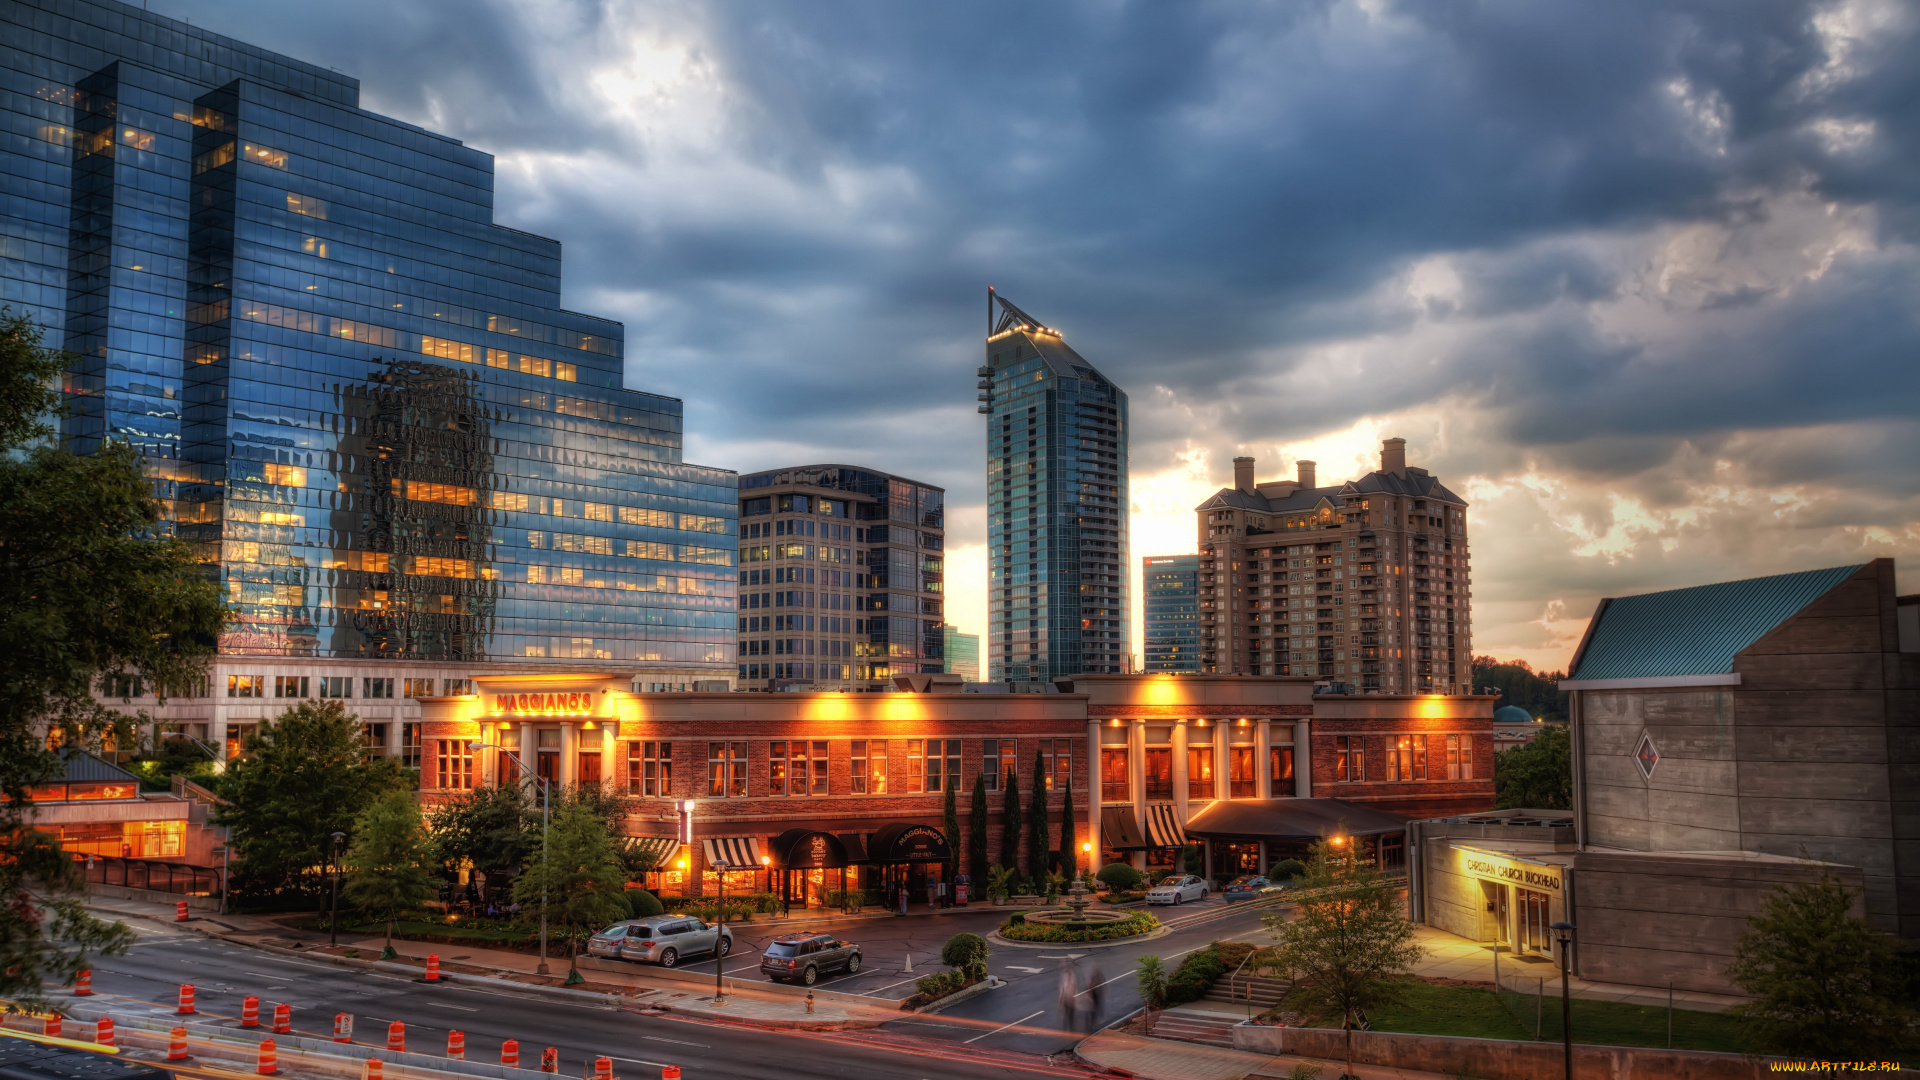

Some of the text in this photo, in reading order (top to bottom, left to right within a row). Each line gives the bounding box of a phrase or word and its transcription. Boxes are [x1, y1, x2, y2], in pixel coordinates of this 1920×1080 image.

[898, 827, 944, 846] MAGGIANO'S
[1467, 859, 1560, 890] CHRISTIAN CHURCH BUCKHEAD
